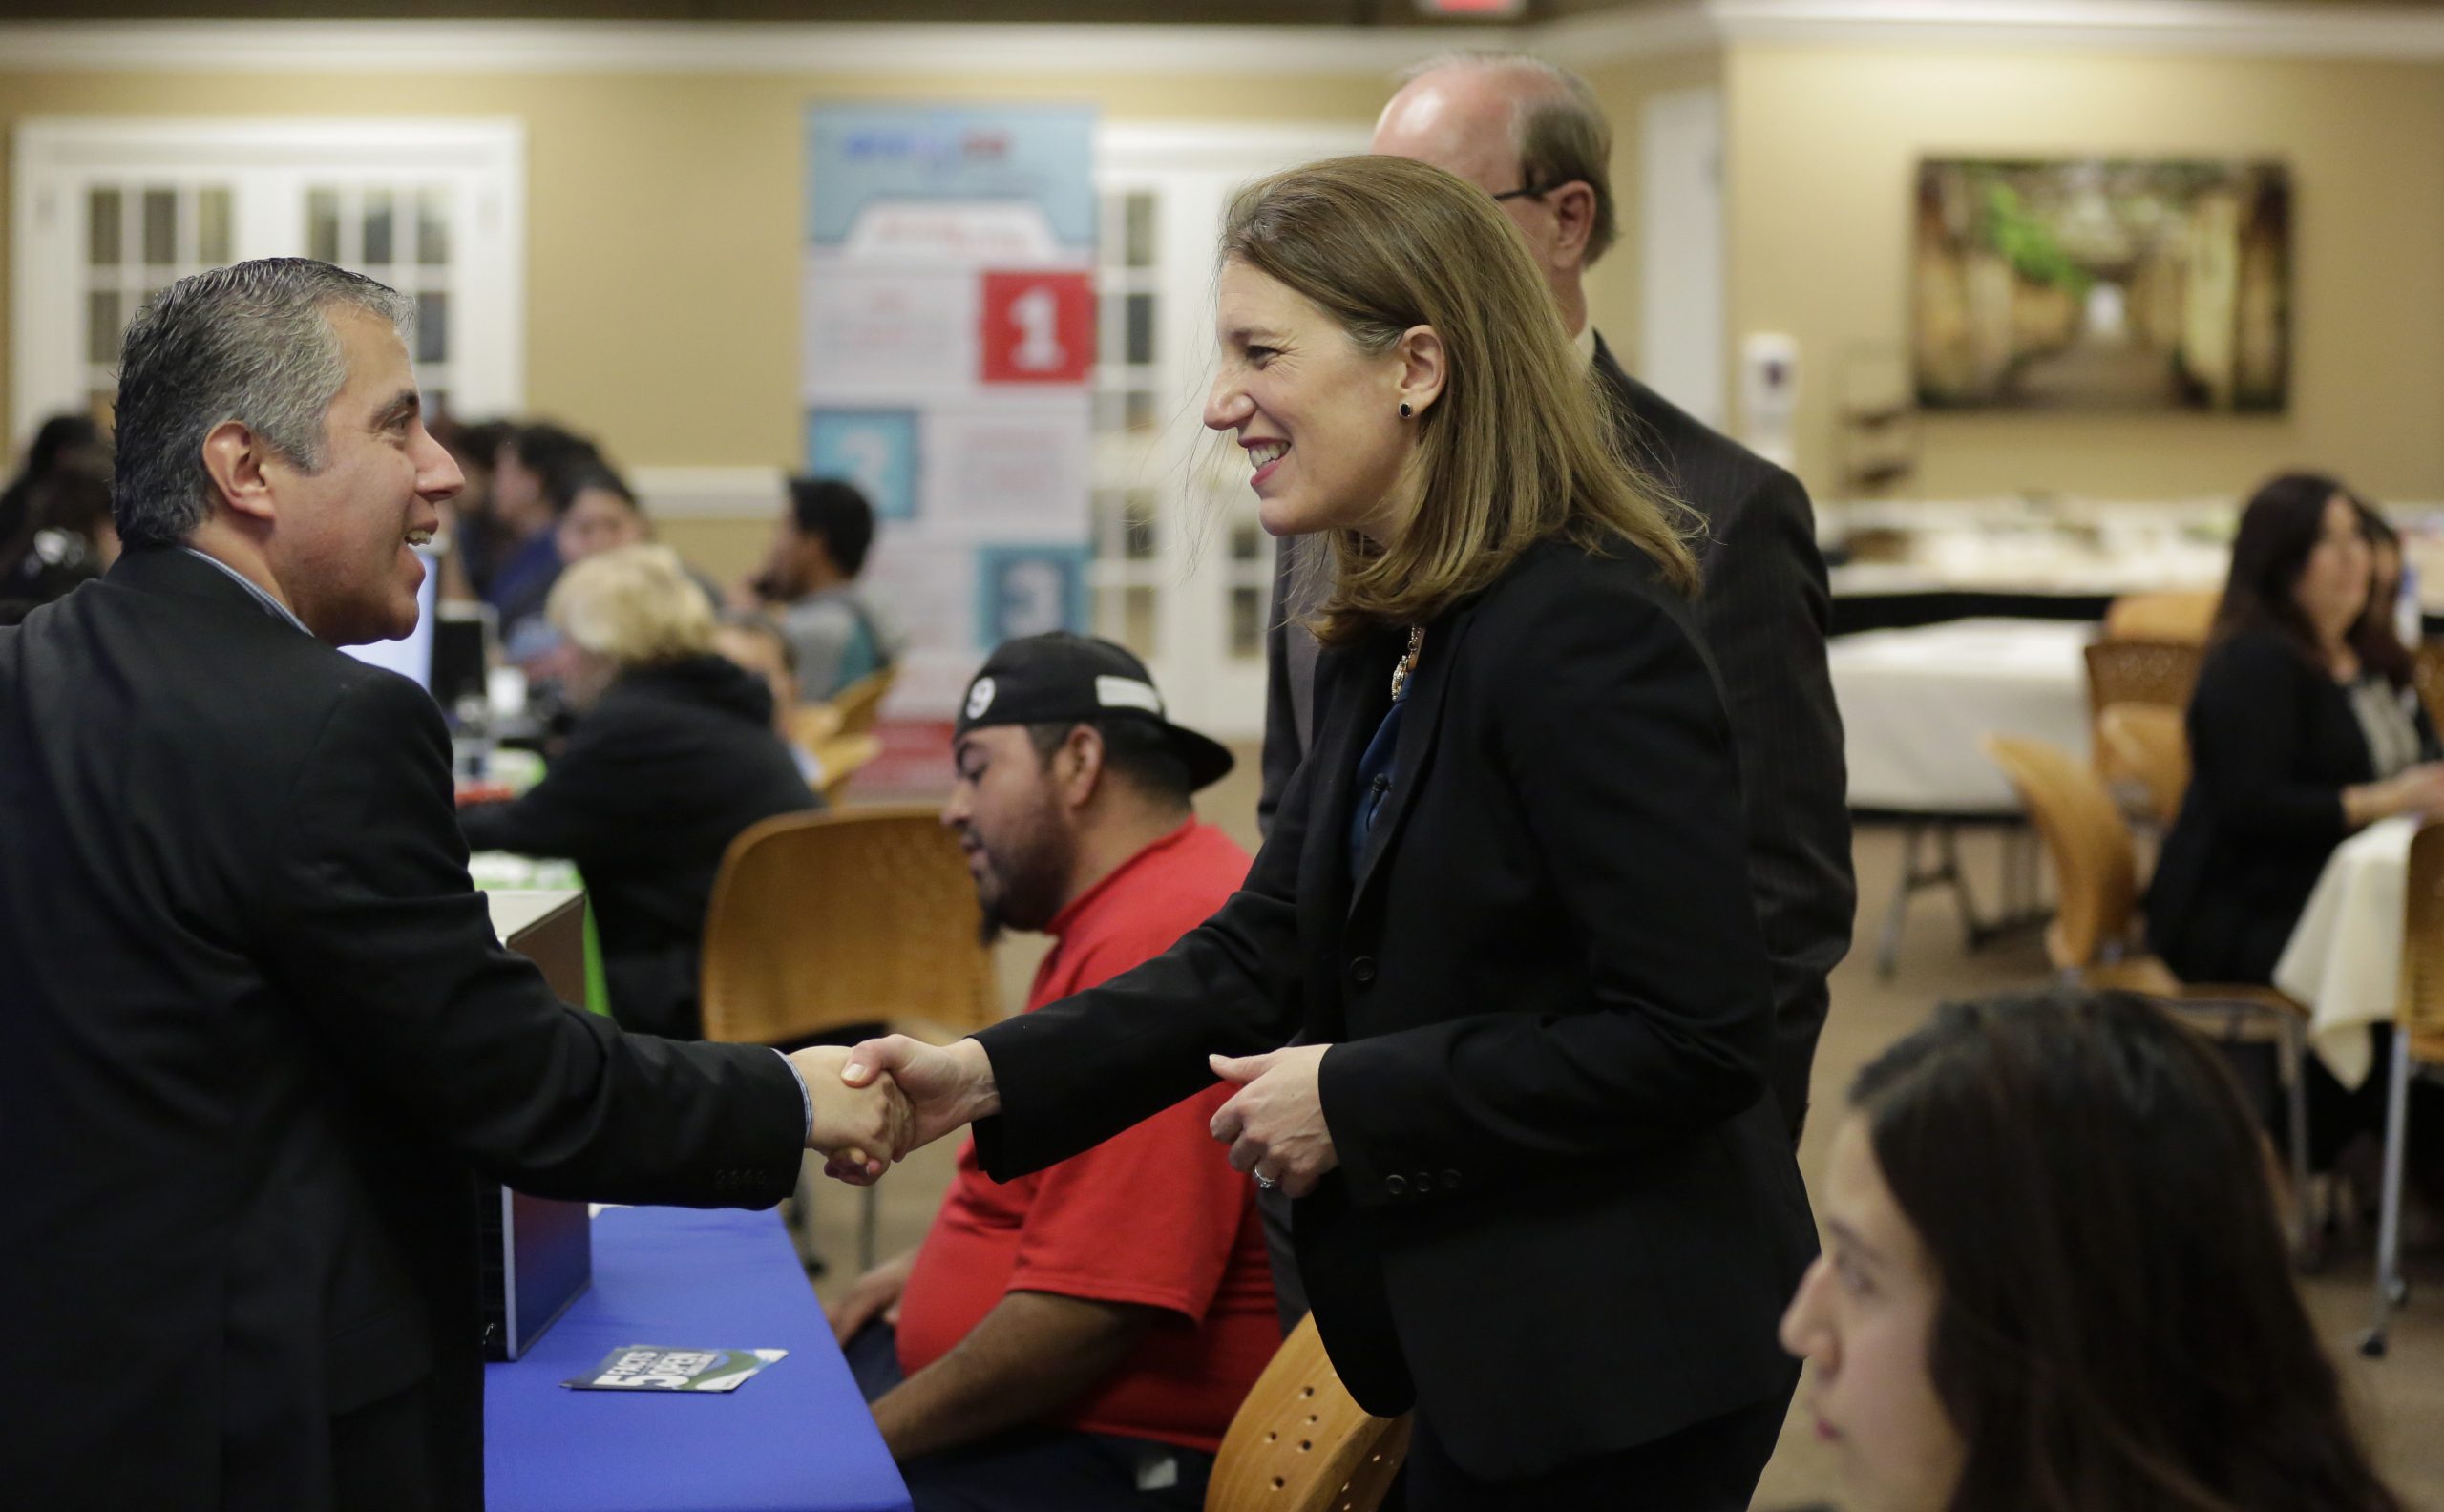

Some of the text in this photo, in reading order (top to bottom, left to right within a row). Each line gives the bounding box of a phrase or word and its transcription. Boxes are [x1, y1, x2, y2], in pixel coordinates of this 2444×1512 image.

[1010, 286, 1065, 371] 1
[1001, 561, 1065, 638] 3
[593, 1375, 689, 1387] 5
